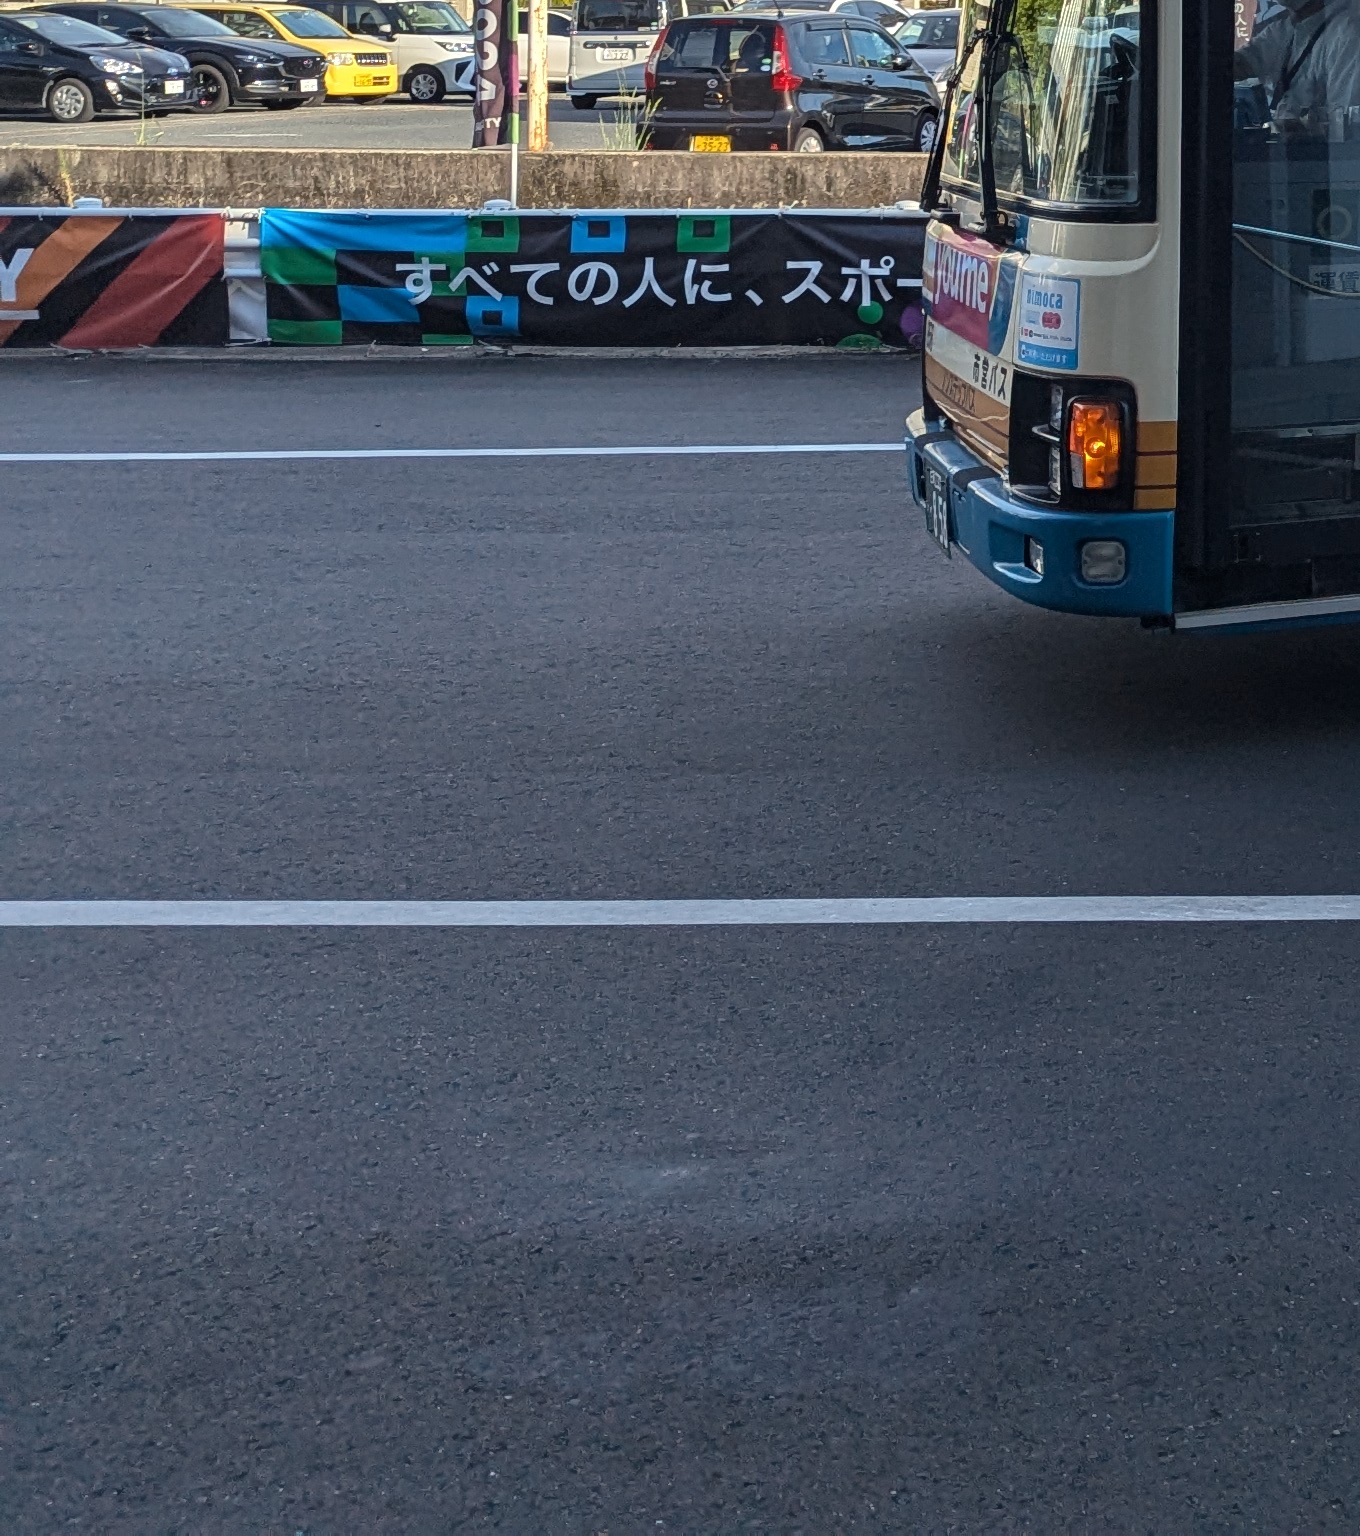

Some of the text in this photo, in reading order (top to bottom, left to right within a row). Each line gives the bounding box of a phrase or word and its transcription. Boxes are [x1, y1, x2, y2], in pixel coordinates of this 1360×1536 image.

[934, 242, 989, 314] youme
[1026, 284, 1063, 310] nimoca
[972, 352, 1008, 401] 市営バス
